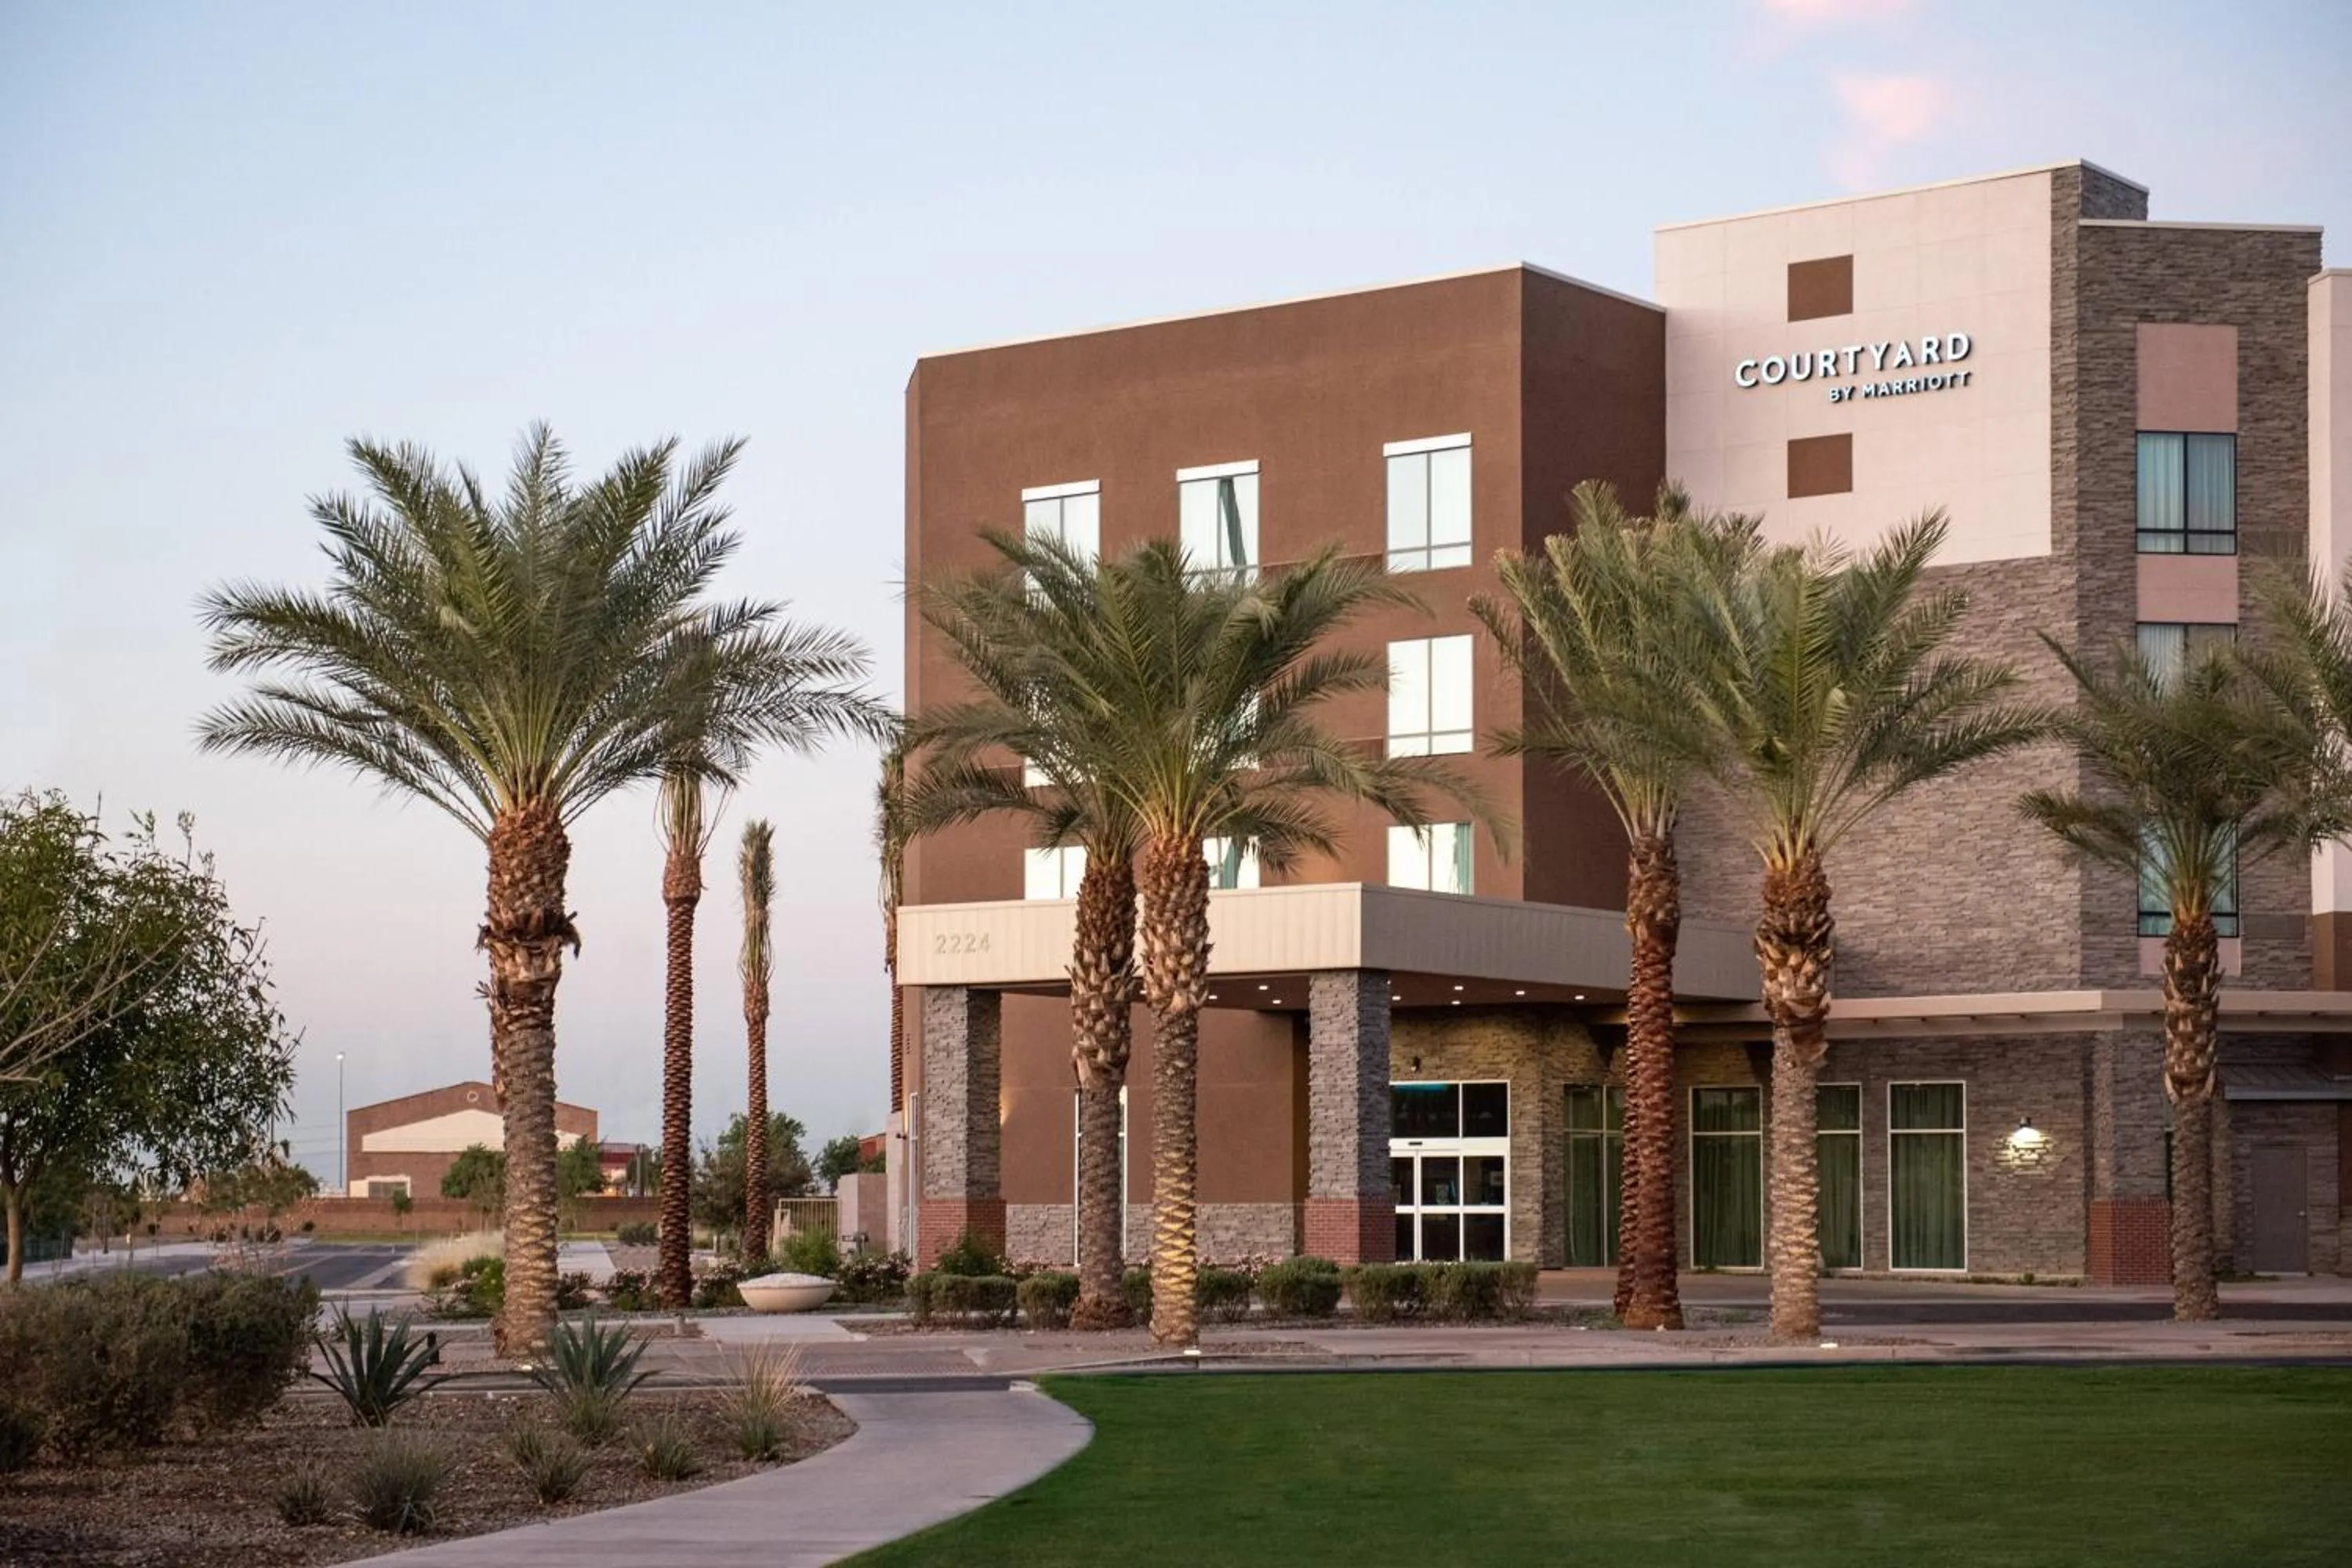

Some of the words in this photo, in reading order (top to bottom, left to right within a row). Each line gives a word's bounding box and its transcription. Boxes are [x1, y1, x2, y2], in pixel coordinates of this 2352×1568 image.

[1734, 332, 1972, 388] COURTYARD
[1829, 385, 1857, 403] BY
[1862, 369, 1972, 398] MARRIOTT
[935, 932, 991, 954] 2224
